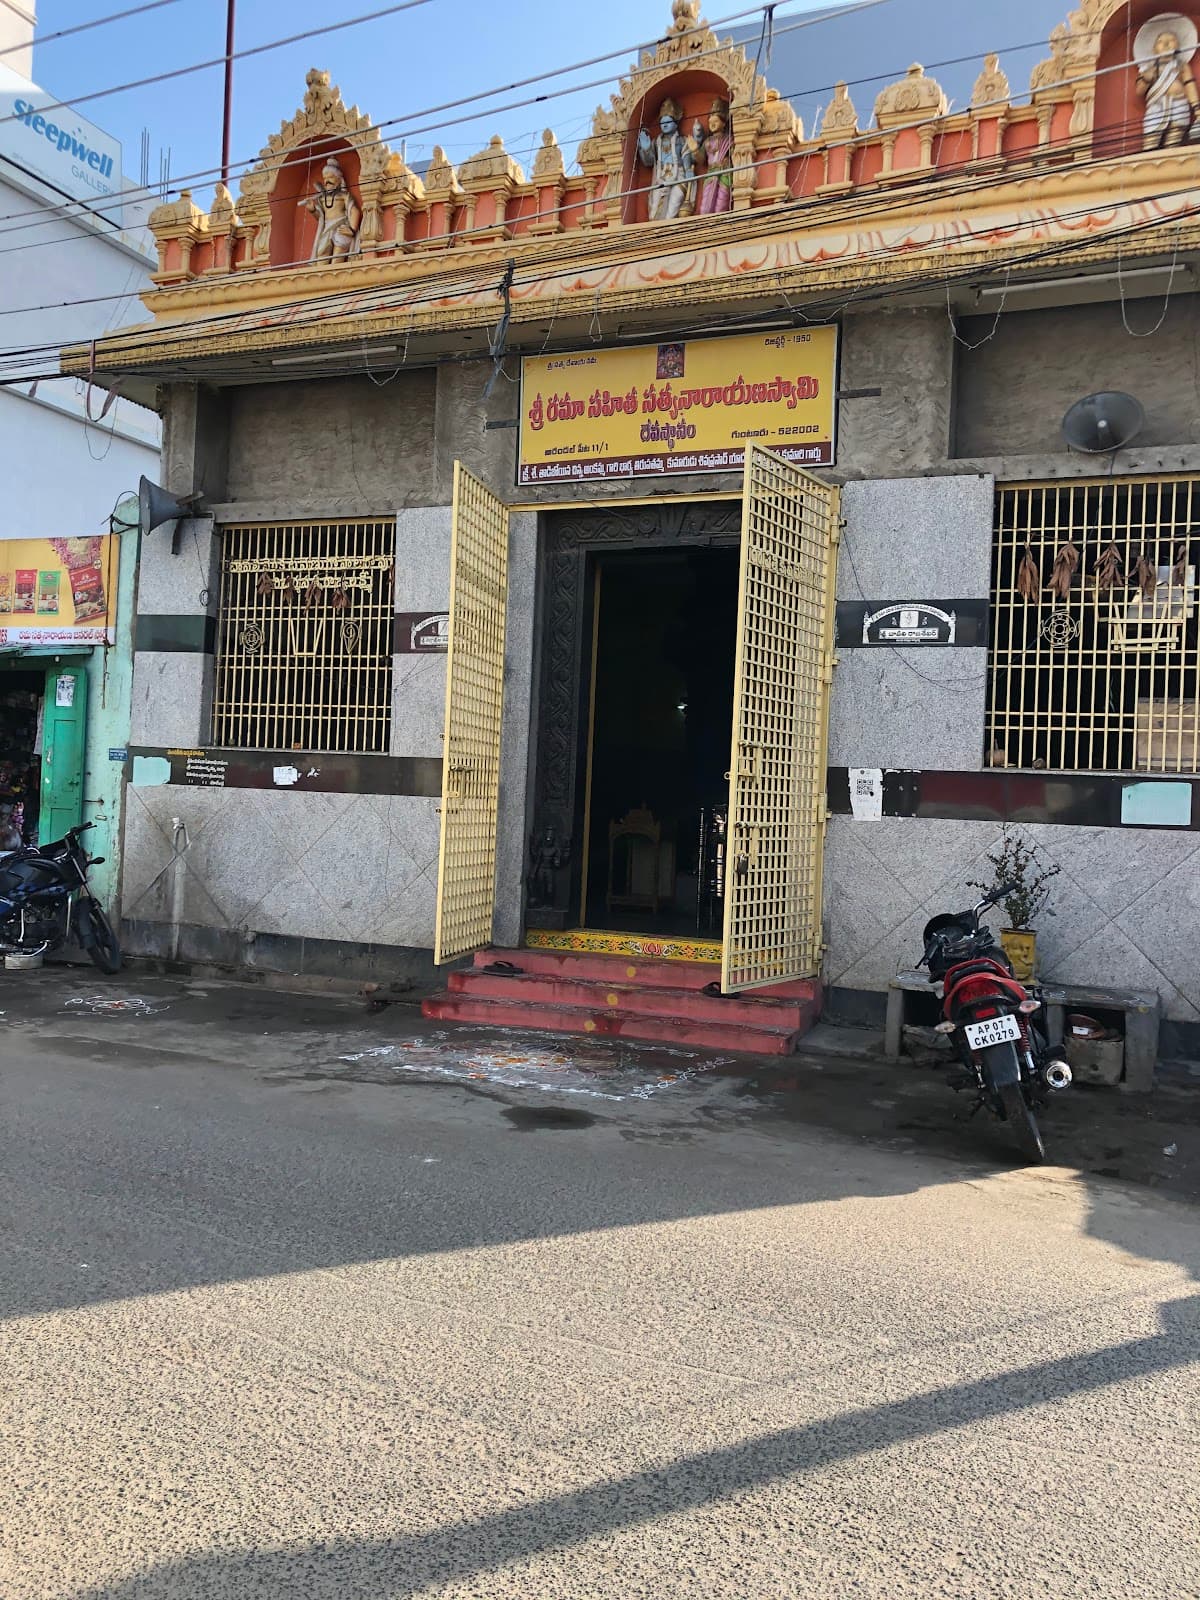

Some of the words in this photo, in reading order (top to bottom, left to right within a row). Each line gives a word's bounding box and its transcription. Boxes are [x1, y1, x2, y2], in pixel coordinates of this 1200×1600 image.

[12, 99, 114, 179] Sleepwell
[528, 392, 545, 431] శ్రీ
[546, 392, 586, 422] రమా
[587, 386, 639, 419] సహిత
[641, 374, 820, 420] సత్యనారాయణస్వామి
[639, 418, 697, 449] దేవస్థానం
[777, 424, 820, 436] 522002
[974, 1028, 1015, 1046] CK0279
[978, 1024, 990, 1034] AP
[992, 1020, 1004, 1031] 07
